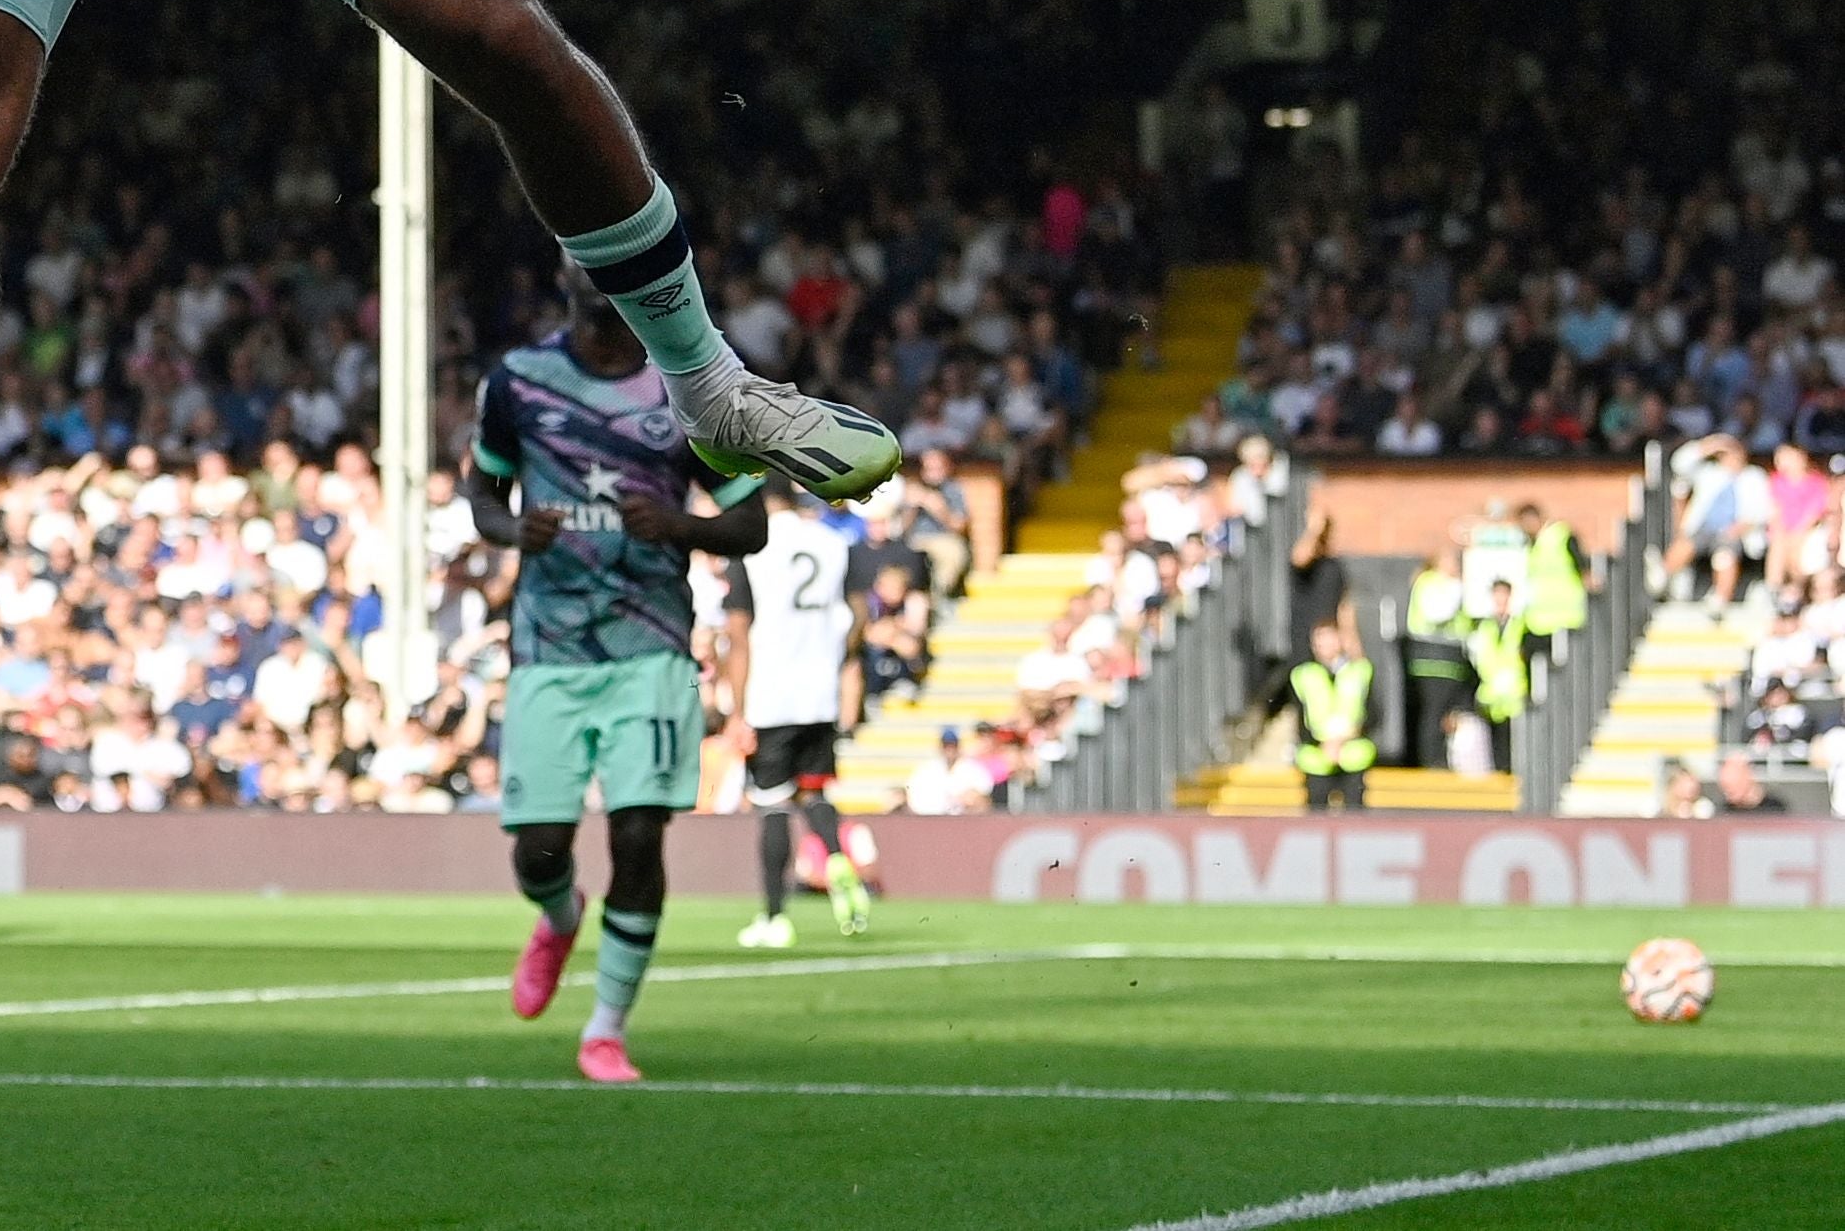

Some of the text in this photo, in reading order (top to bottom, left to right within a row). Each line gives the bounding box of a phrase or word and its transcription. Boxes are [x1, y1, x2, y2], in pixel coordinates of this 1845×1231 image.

[647, 298, 691, 321] umbro
[791, 552, 829, 610] 2
[649, 717, 676, 766] 11
[993, 827, 1426, 902] COME
[1459, 827, 1689, 904] ON
